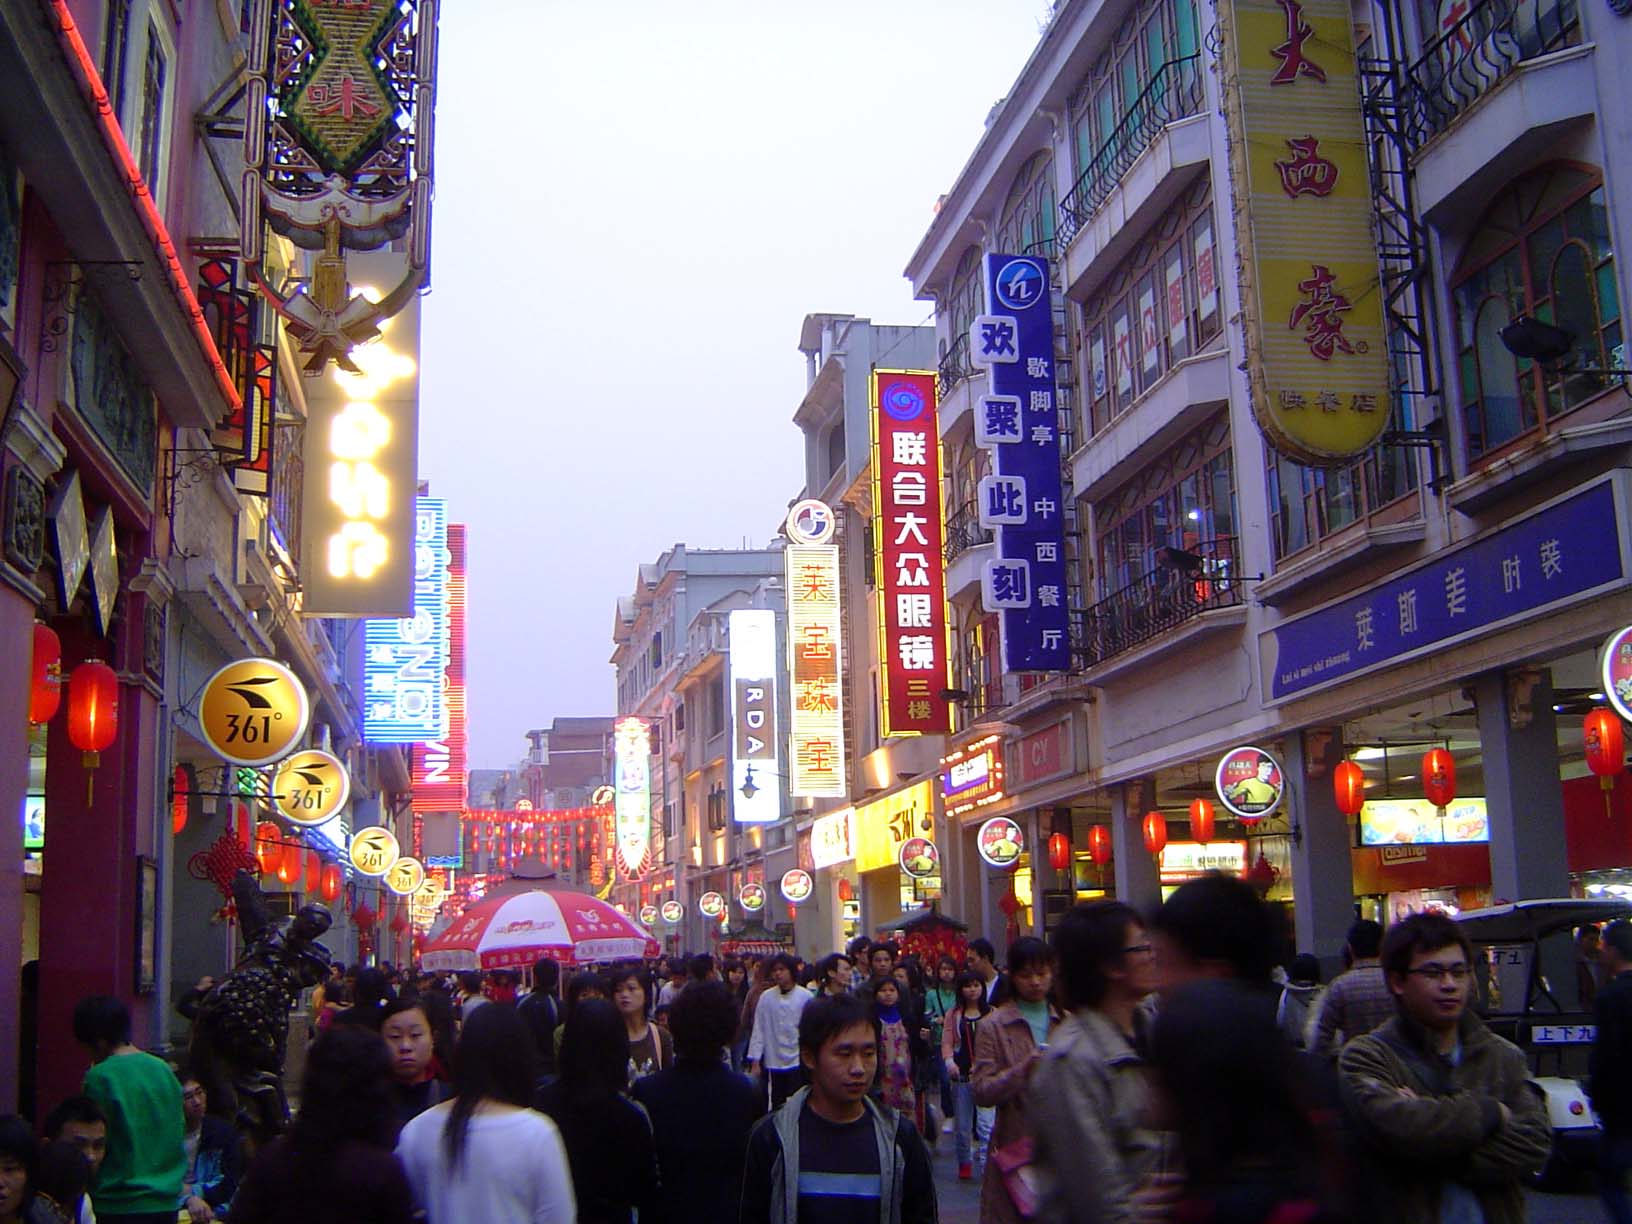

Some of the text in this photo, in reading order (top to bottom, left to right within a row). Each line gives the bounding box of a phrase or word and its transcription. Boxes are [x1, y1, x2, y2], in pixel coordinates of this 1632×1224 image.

[982, 322, 1026, 602] 欢聚此刻
[892, 431, 935, 671] 联合大众眼镜
[1034, 497, 1062, 650] 中西餐厅
[226, 711, 282, 744] 361°
[802, 564, 832, 773] 莱宝珠宝
[907, 679, 932, 720] 三楼
[1537, 1026, 1594, 1041] 上下九
